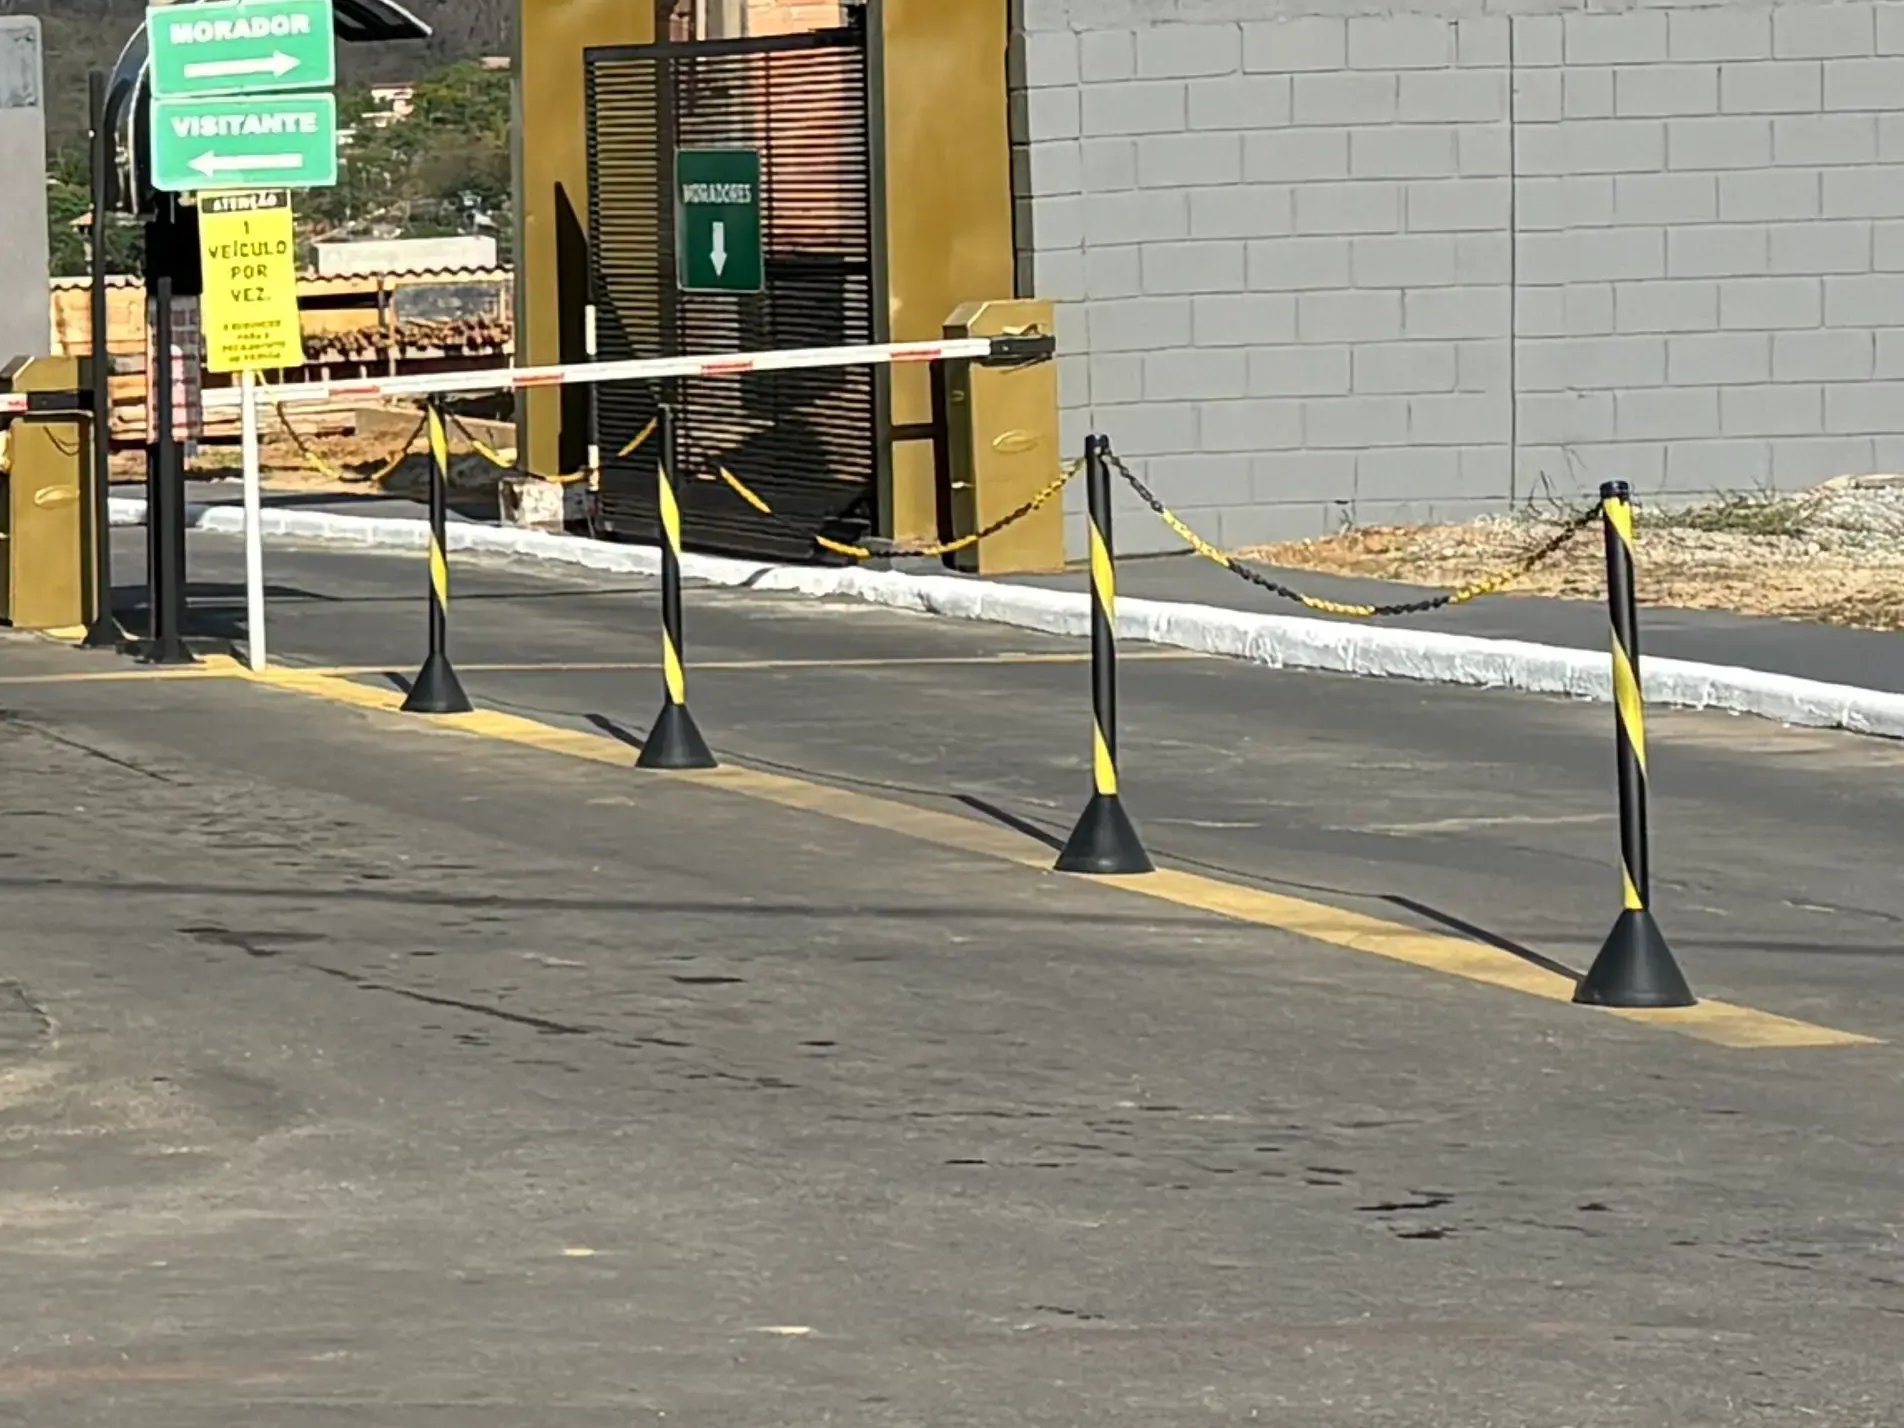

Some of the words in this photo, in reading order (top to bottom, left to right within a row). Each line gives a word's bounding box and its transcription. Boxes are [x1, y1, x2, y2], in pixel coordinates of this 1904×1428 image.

[169, 14, 311, 45] MORADOR
[170, 111, 318, 138] VISITANTE
[682, 183, 751, 204] MORADORES
[243, 220, 250, 235] 1
[208, 240, 288, 260] VEÍCULO
[230, 263, 268, 280] POR
